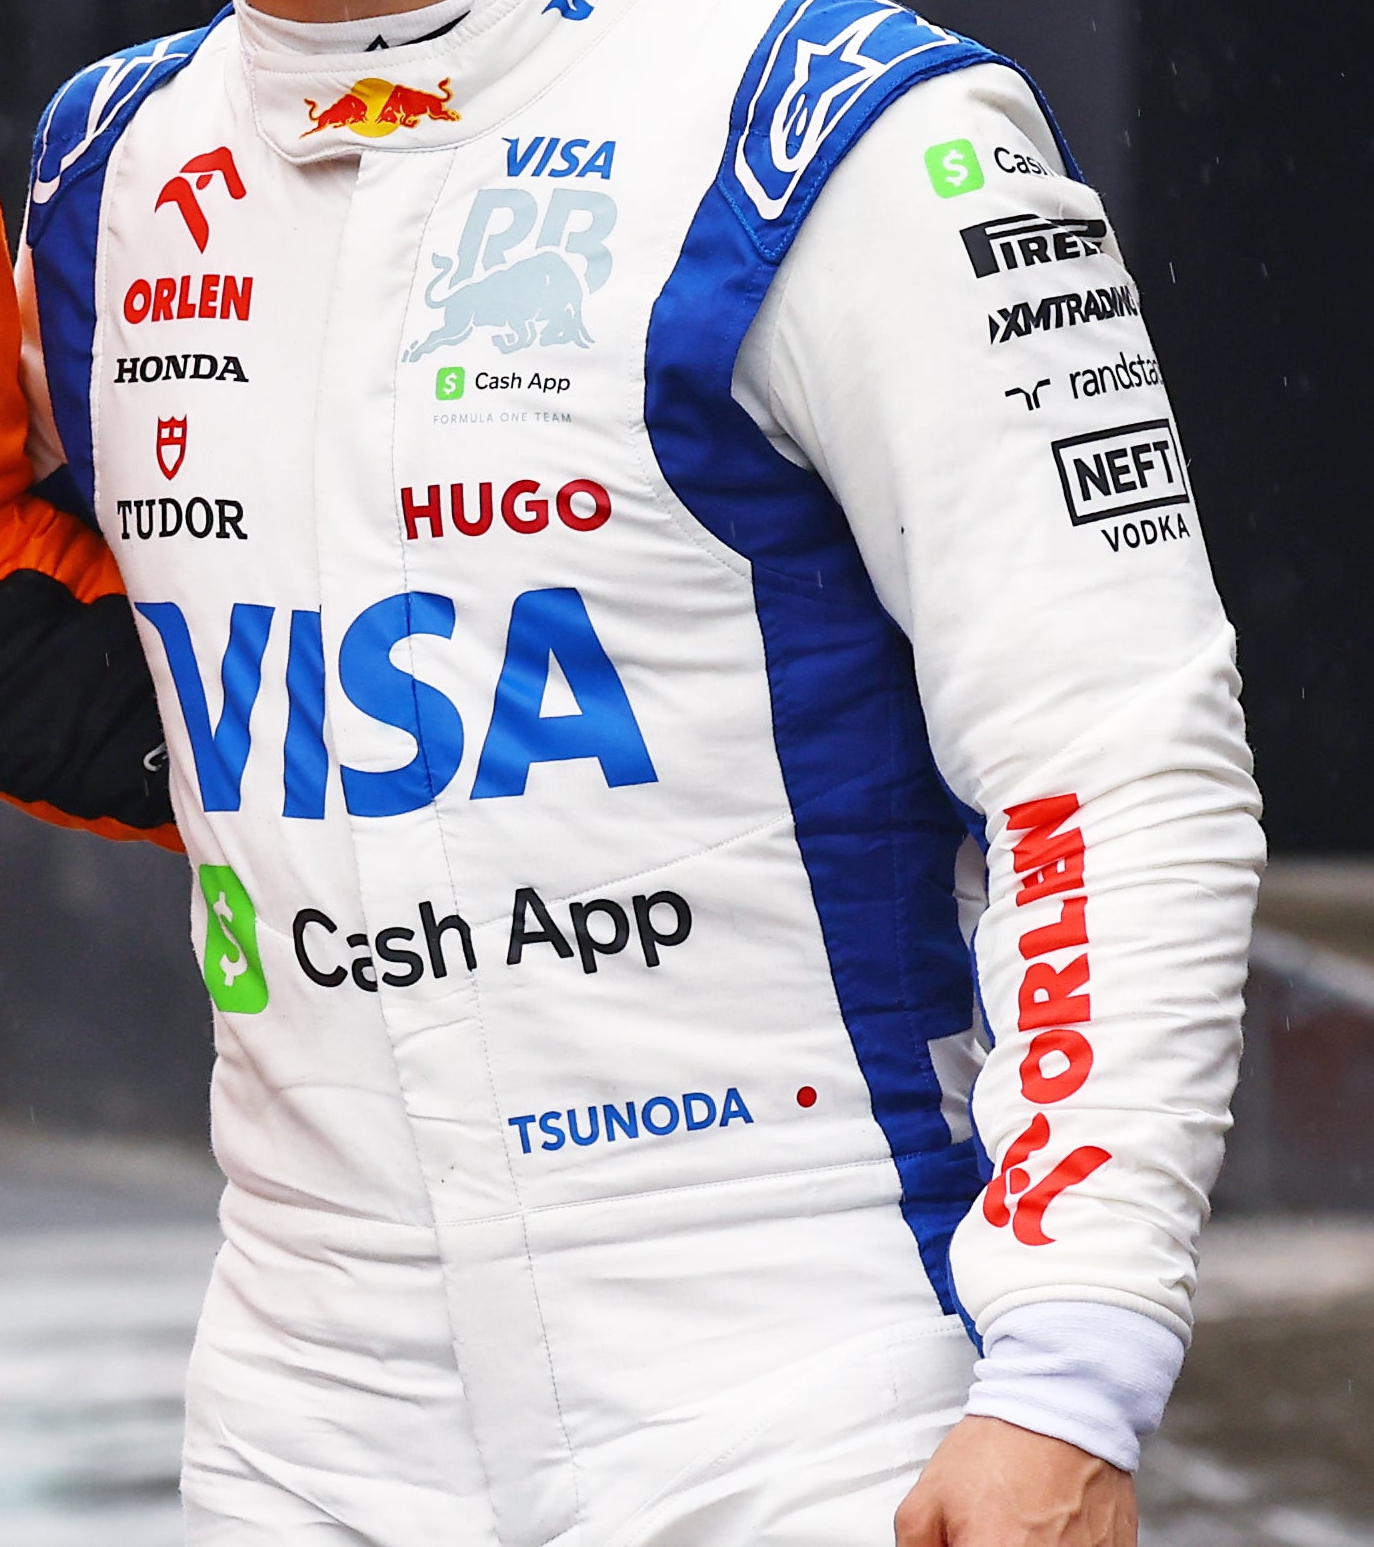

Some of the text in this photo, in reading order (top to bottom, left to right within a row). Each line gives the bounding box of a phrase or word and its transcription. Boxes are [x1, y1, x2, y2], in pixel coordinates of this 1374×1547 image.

[500, 136, 618, 181] VISA
[993, 146, 1048, 176] Cas
[123, 273, 255, 325] ORLEN
[113, 353, 249, 383] HONDA
[474, 371, 523, 391] Cash
[527, 372, 572, 394] App
[433, 412, 573, 425] FORMULA ONE TEAM
[1072, 440, 1174, 502] NEFT
[116, 496, 249, 541] TUDOR
[400, 478, 613, 541] HUGO
[1100, 513, 1191, 553] VODKA
[134, 586, 660, 821] VISA
[292, 900, 478, 993] Cash
[506, 886, 694, 975] App
[1002, 792, 1094, 1105] ORLEN
[507, 1086, 755, 1155] TSUNODA
